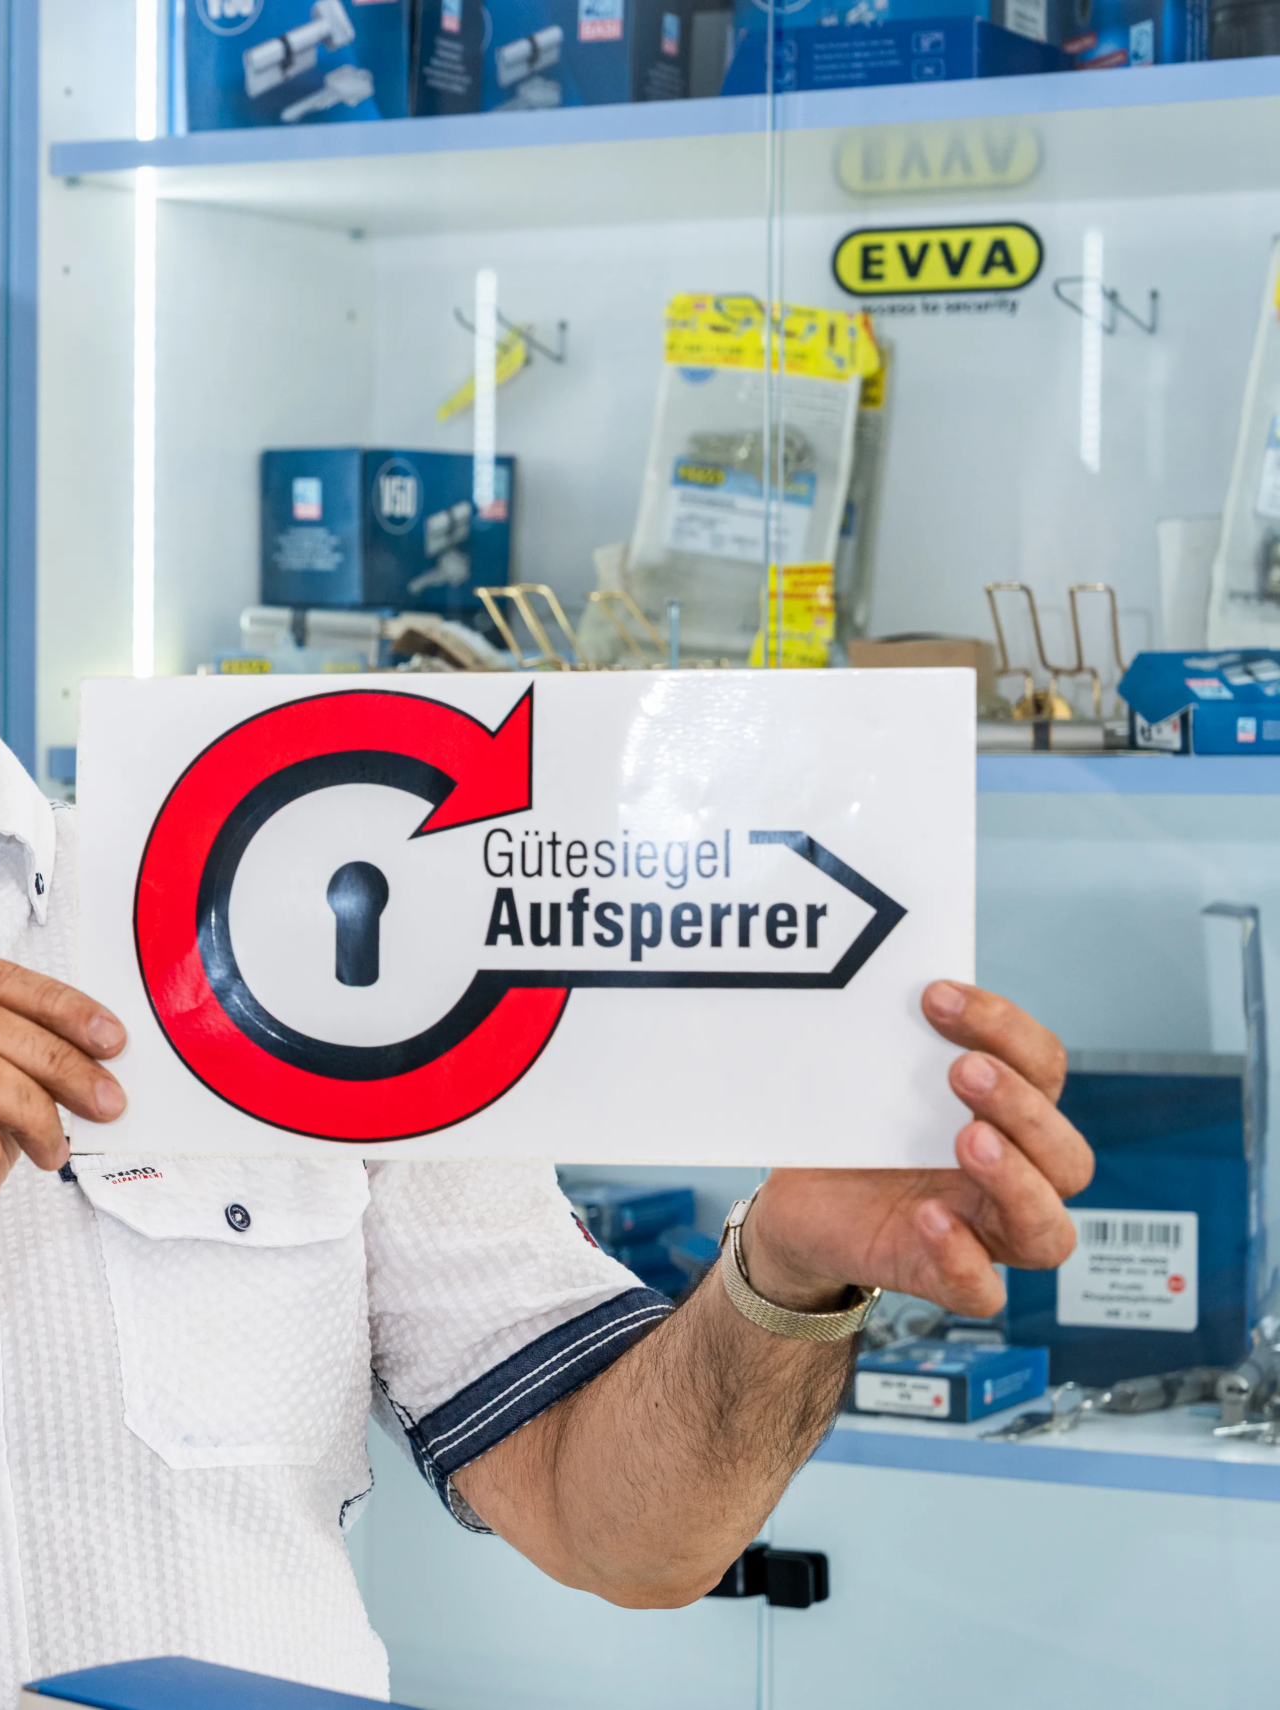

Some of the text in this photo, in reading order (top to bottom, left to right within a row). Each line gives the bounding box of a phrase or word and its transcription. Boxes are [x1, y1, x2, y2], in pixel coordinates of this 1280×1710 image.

[860, 239, 1017, 282] EVVA
[482, 828, 731, 889] Gütesiegel
[483, 887, 827, 961] Aufsperrer
